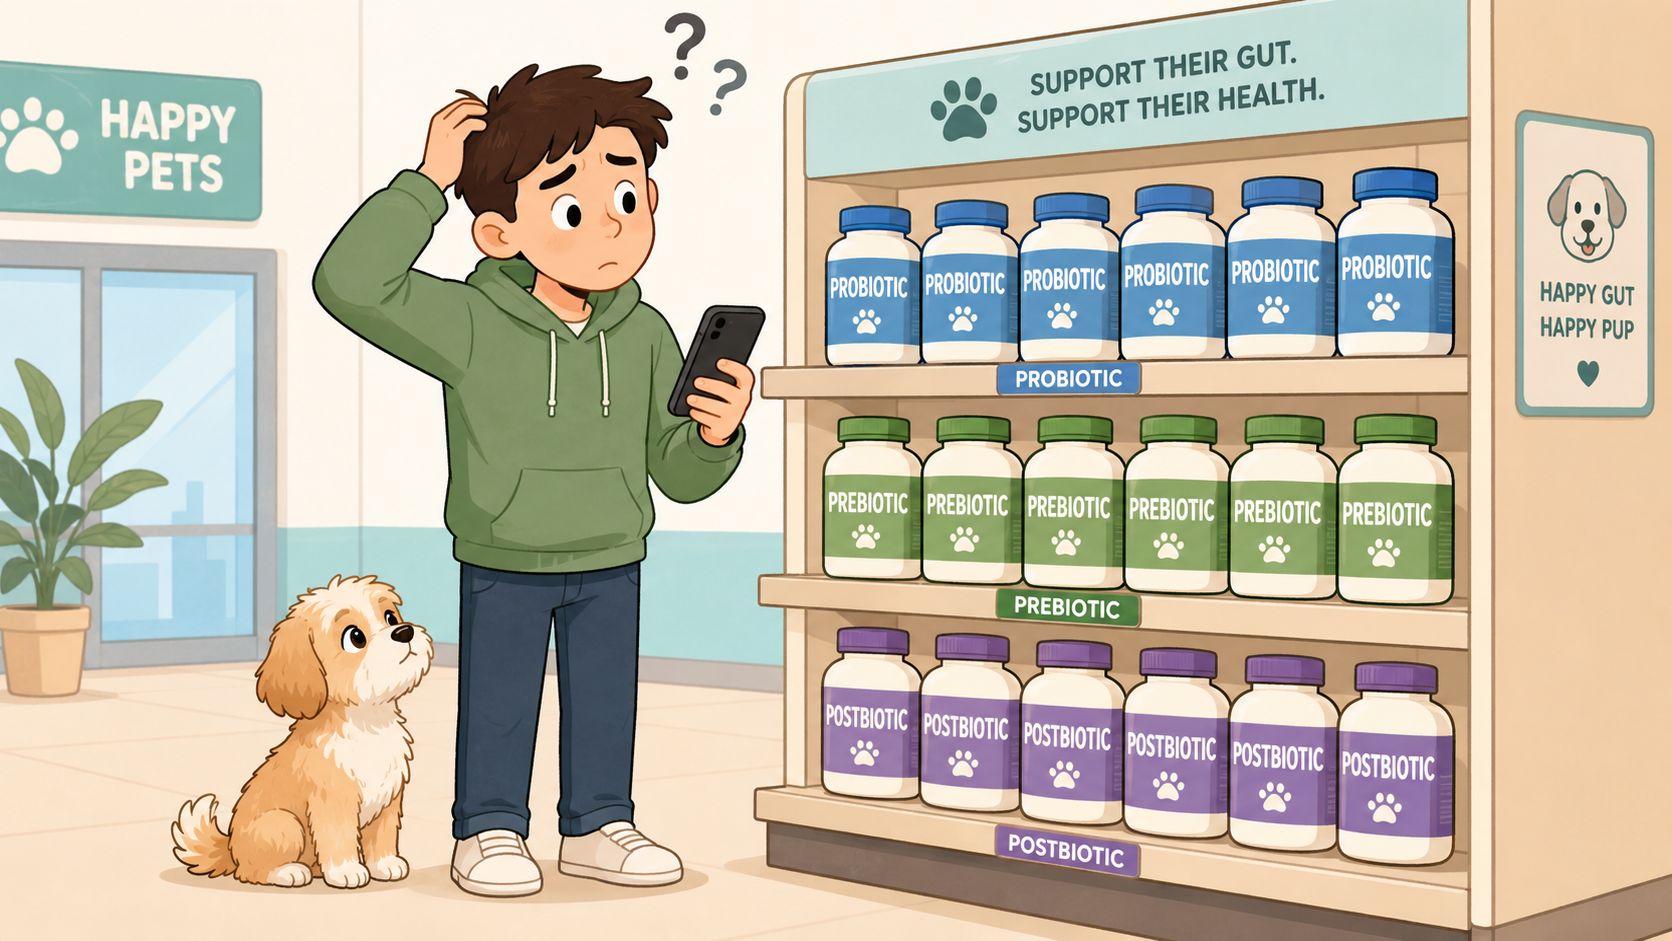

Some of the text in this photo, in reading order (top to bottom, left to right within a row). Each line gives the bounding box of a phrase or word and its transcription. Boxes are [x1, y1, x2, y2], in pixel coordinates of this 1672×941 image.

[664, 12, 706, 81] ?
[1030, 39, 1297, 96] SUPPORT THEIR GUT.
[709, 58, 748, 116] ?
[1018, 76, 1325, 134] SUPPORT THEIR HEALTH.
[101, 97, 237, 144] HAPPY
[124, 150, 224, 193] PETS
[1023, 267, 1106, 292] PROBIOTIC
[1124, 261, 1210, 289] PROBIOTIC
[1231, 258, 1320, 285] PROBIOTIC
[1341, 254, 1432, 281] PROBIOTIC
[830, 275, 908, 299] PROBIOTIC
[925, 271, 1006, 296] PROBIOTIC
[1540, 280, 1635, 306] HAPPY GUT
[1540, 316, 1635, 340] HAPPY PUP
[1015, 368, 1122, 388] PROBIOTIC
[828, 491, 908, 514] PREBIOTIC
[927, 493, 1009, 517] PREBIOTIC
[1027, 495, 1111, 519] PREBIOTIC
[1129, 497, 1215, 522] PREBIOTIC
[1234, 499, 1321, 525] PREBIOTIC
[1342, 501, 1433, 527] PREBIOTIC
[1014, 595, 1120, 620] PREBIOTIC
[826, 703, 908, 731] POSTBIOTIC
[923, 712, 1009, 741] POSTBIOTIC
[1024, 721, 1111, 751] POSTBIOTIC
[1127, 731, 1217, 761] POSTBIOTIC
[1233, 741, 1324, 772] POSTBIOTIC
[1342, 750, 1435, 782] POSTBIOTIC
[1008, 833, 1125, 868] POSTBIOTIC
